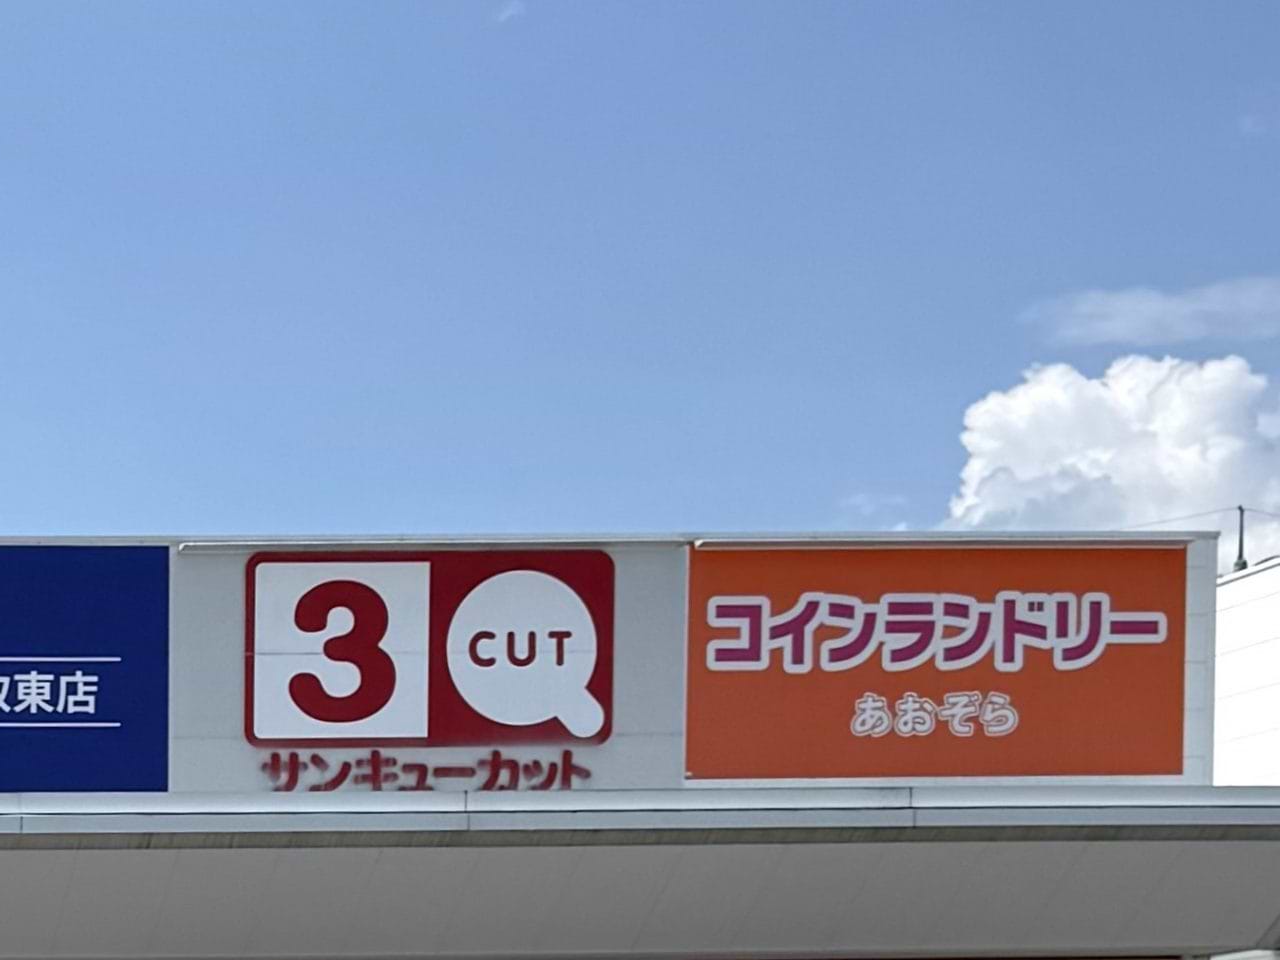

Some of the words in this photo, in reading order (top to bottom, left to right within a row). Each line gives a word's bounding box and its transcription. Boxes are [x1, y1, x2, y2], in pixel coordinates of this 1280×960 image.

[468, 629, 574, 668] CUT
[707, 591, 1167, 673] コインランドリー
[851, 692, 1018, 737] あおぞら
[261, 750, 593, 791] サンキューカット
